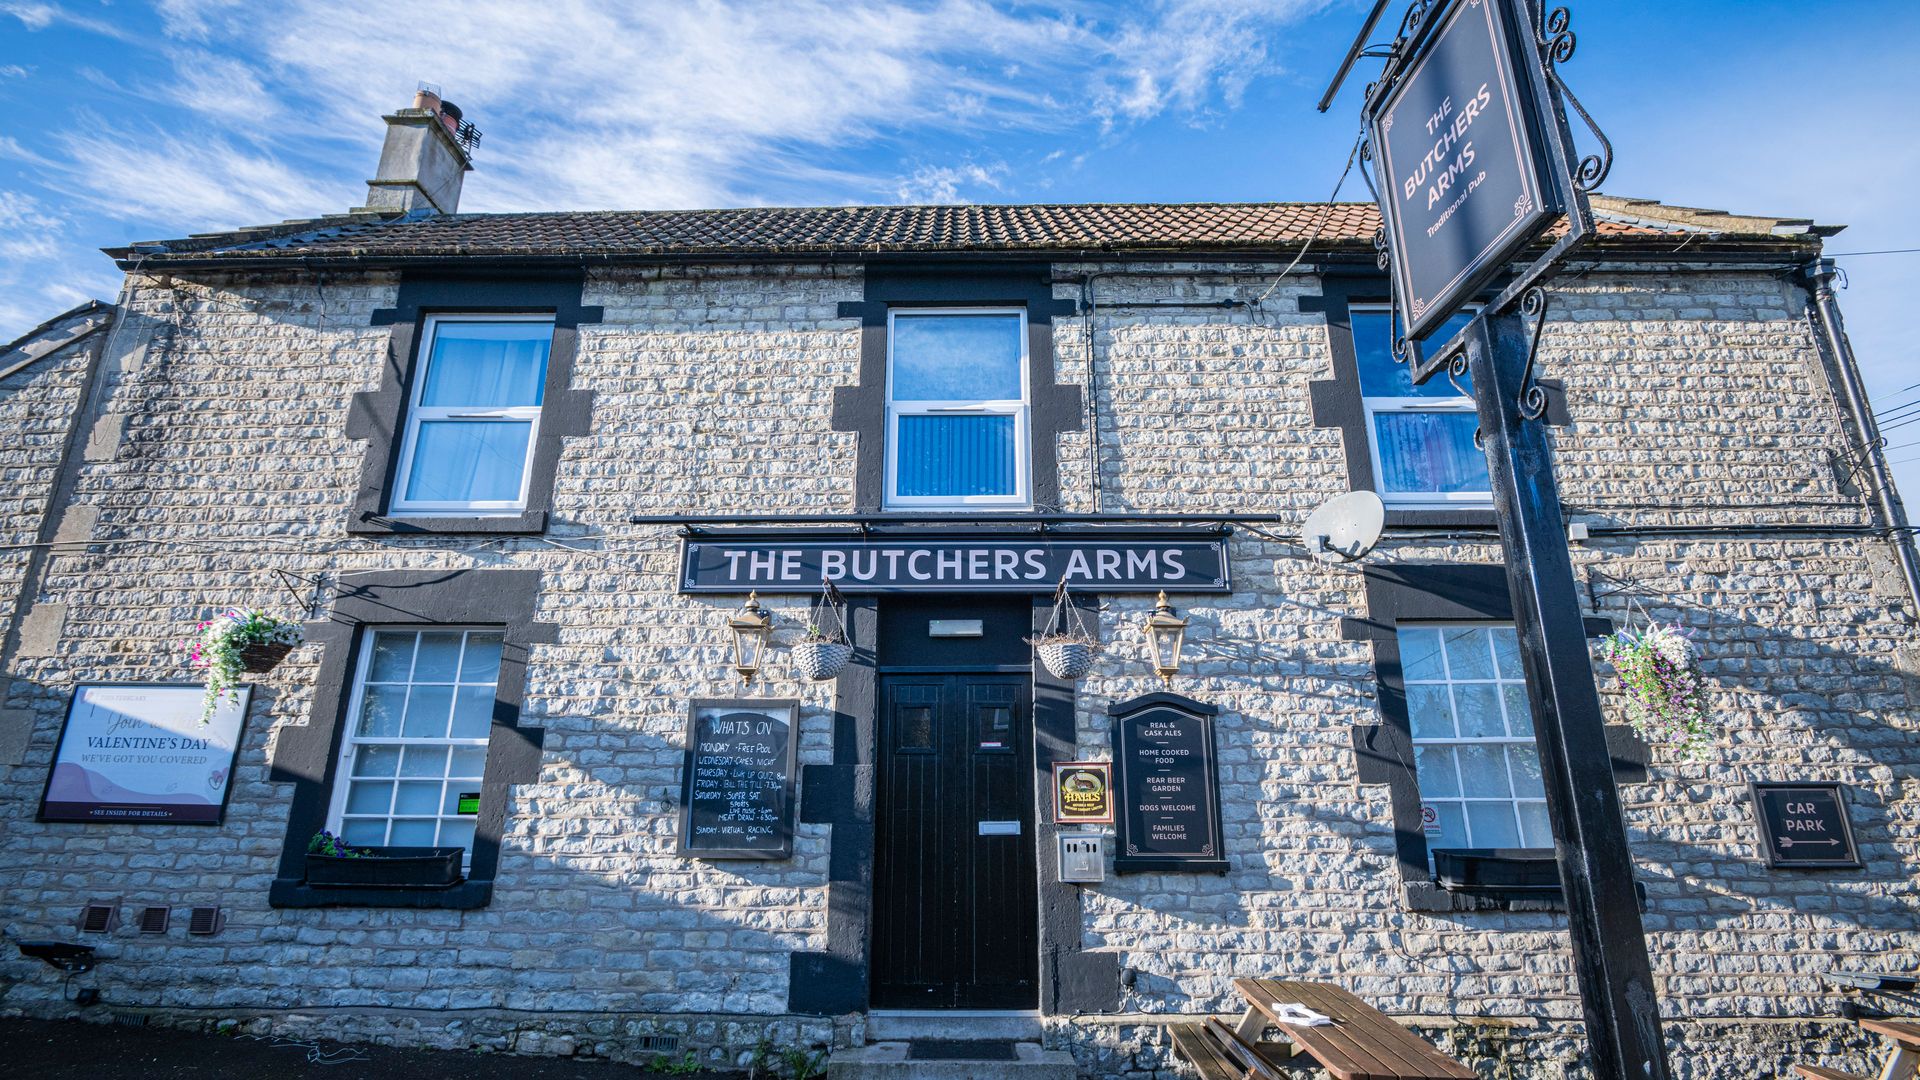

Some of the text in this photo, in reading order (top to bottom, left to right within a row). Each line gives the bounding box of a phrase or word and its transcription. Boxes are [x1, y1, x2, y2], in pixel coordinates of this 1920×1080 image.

[1425, 95, 1452, 137] THE
[1404, 83, 1491, 201] BUTCHERS
[1427, 141, 1477, 211] ARMS
[1426, 170, 1487, 238] Traditional Pub
[723, 549, 1187, 581] THE BUTCHERS ARMS
[106, 708, 145, 735] Join
[756, 721, 773, 735] ON
[87, 736, 211, 750] VALENTINE'S DAY
[700, 742, 730, 752] MONDAY
[756, 743, 771, 754] POOL
[81, 753, 207, 765] WE'VE GOT YOU COVERED
[698, 756, 733, 765] WEDNESDAY
[757, 758, 776, 766] NIGHT
[697, 768, 729, 777] THURSDAY
[757, 771, 773, 780] QUIZ
[696, 780, 718, 788] FRIDAY
[694, 790, 721, 800] SATURDAY
[749, 791, 761, 800] SAT
[106, 809, 127, 817] INSIDE
[1786, 802, 1816, 814] CAR
[718, 814, 736, 822] MEAT
[696, 825, 717, 834] SUNDAY
[722, 826, 744, 834] VIRTUAL
[748, 826, 773, 834] RACING
[1785, 819, 1826, 831] PARK
